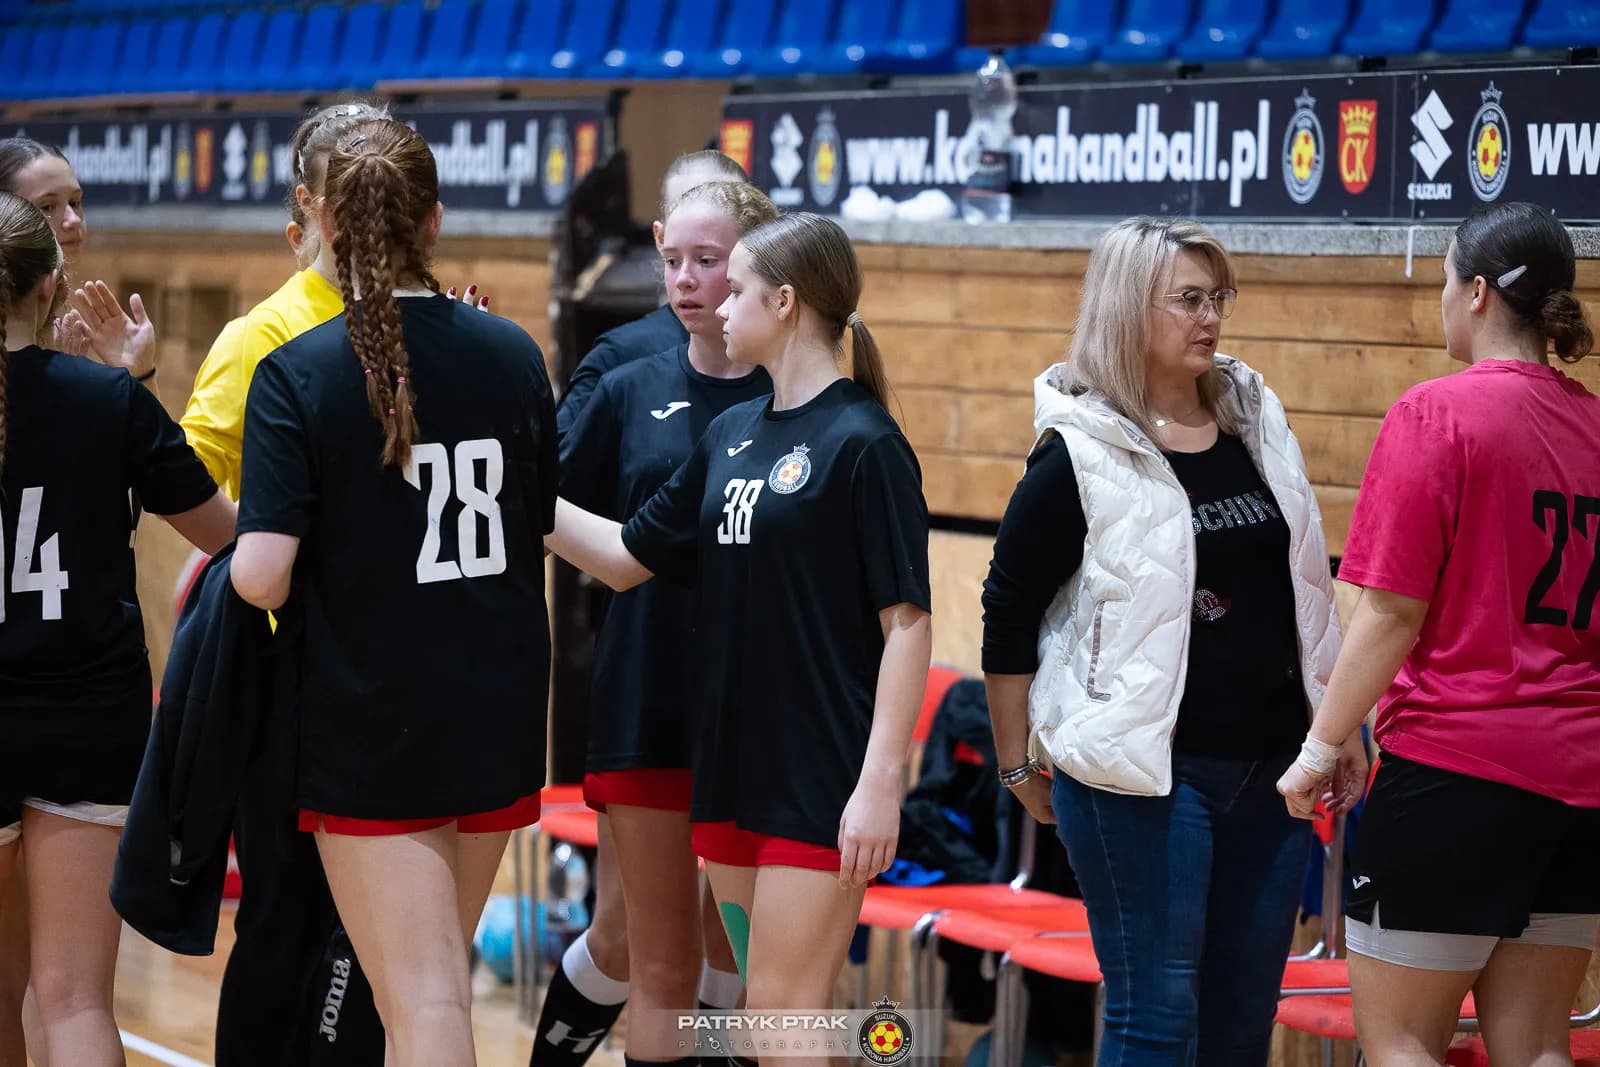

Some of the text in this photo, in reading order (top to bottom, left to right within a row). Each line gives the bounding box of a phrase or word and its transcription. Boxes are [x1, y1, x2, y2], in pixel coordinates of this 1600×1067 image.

[1341, 137, 1369, 183] CK
[1408, 183, 1452, 200] SUZUKI
[0, 486, 69, 624] 4
[402, 438, 507, 584] 28
[717, 478, 765, 544] 38
[1524, 489, 1600, 631] 27
